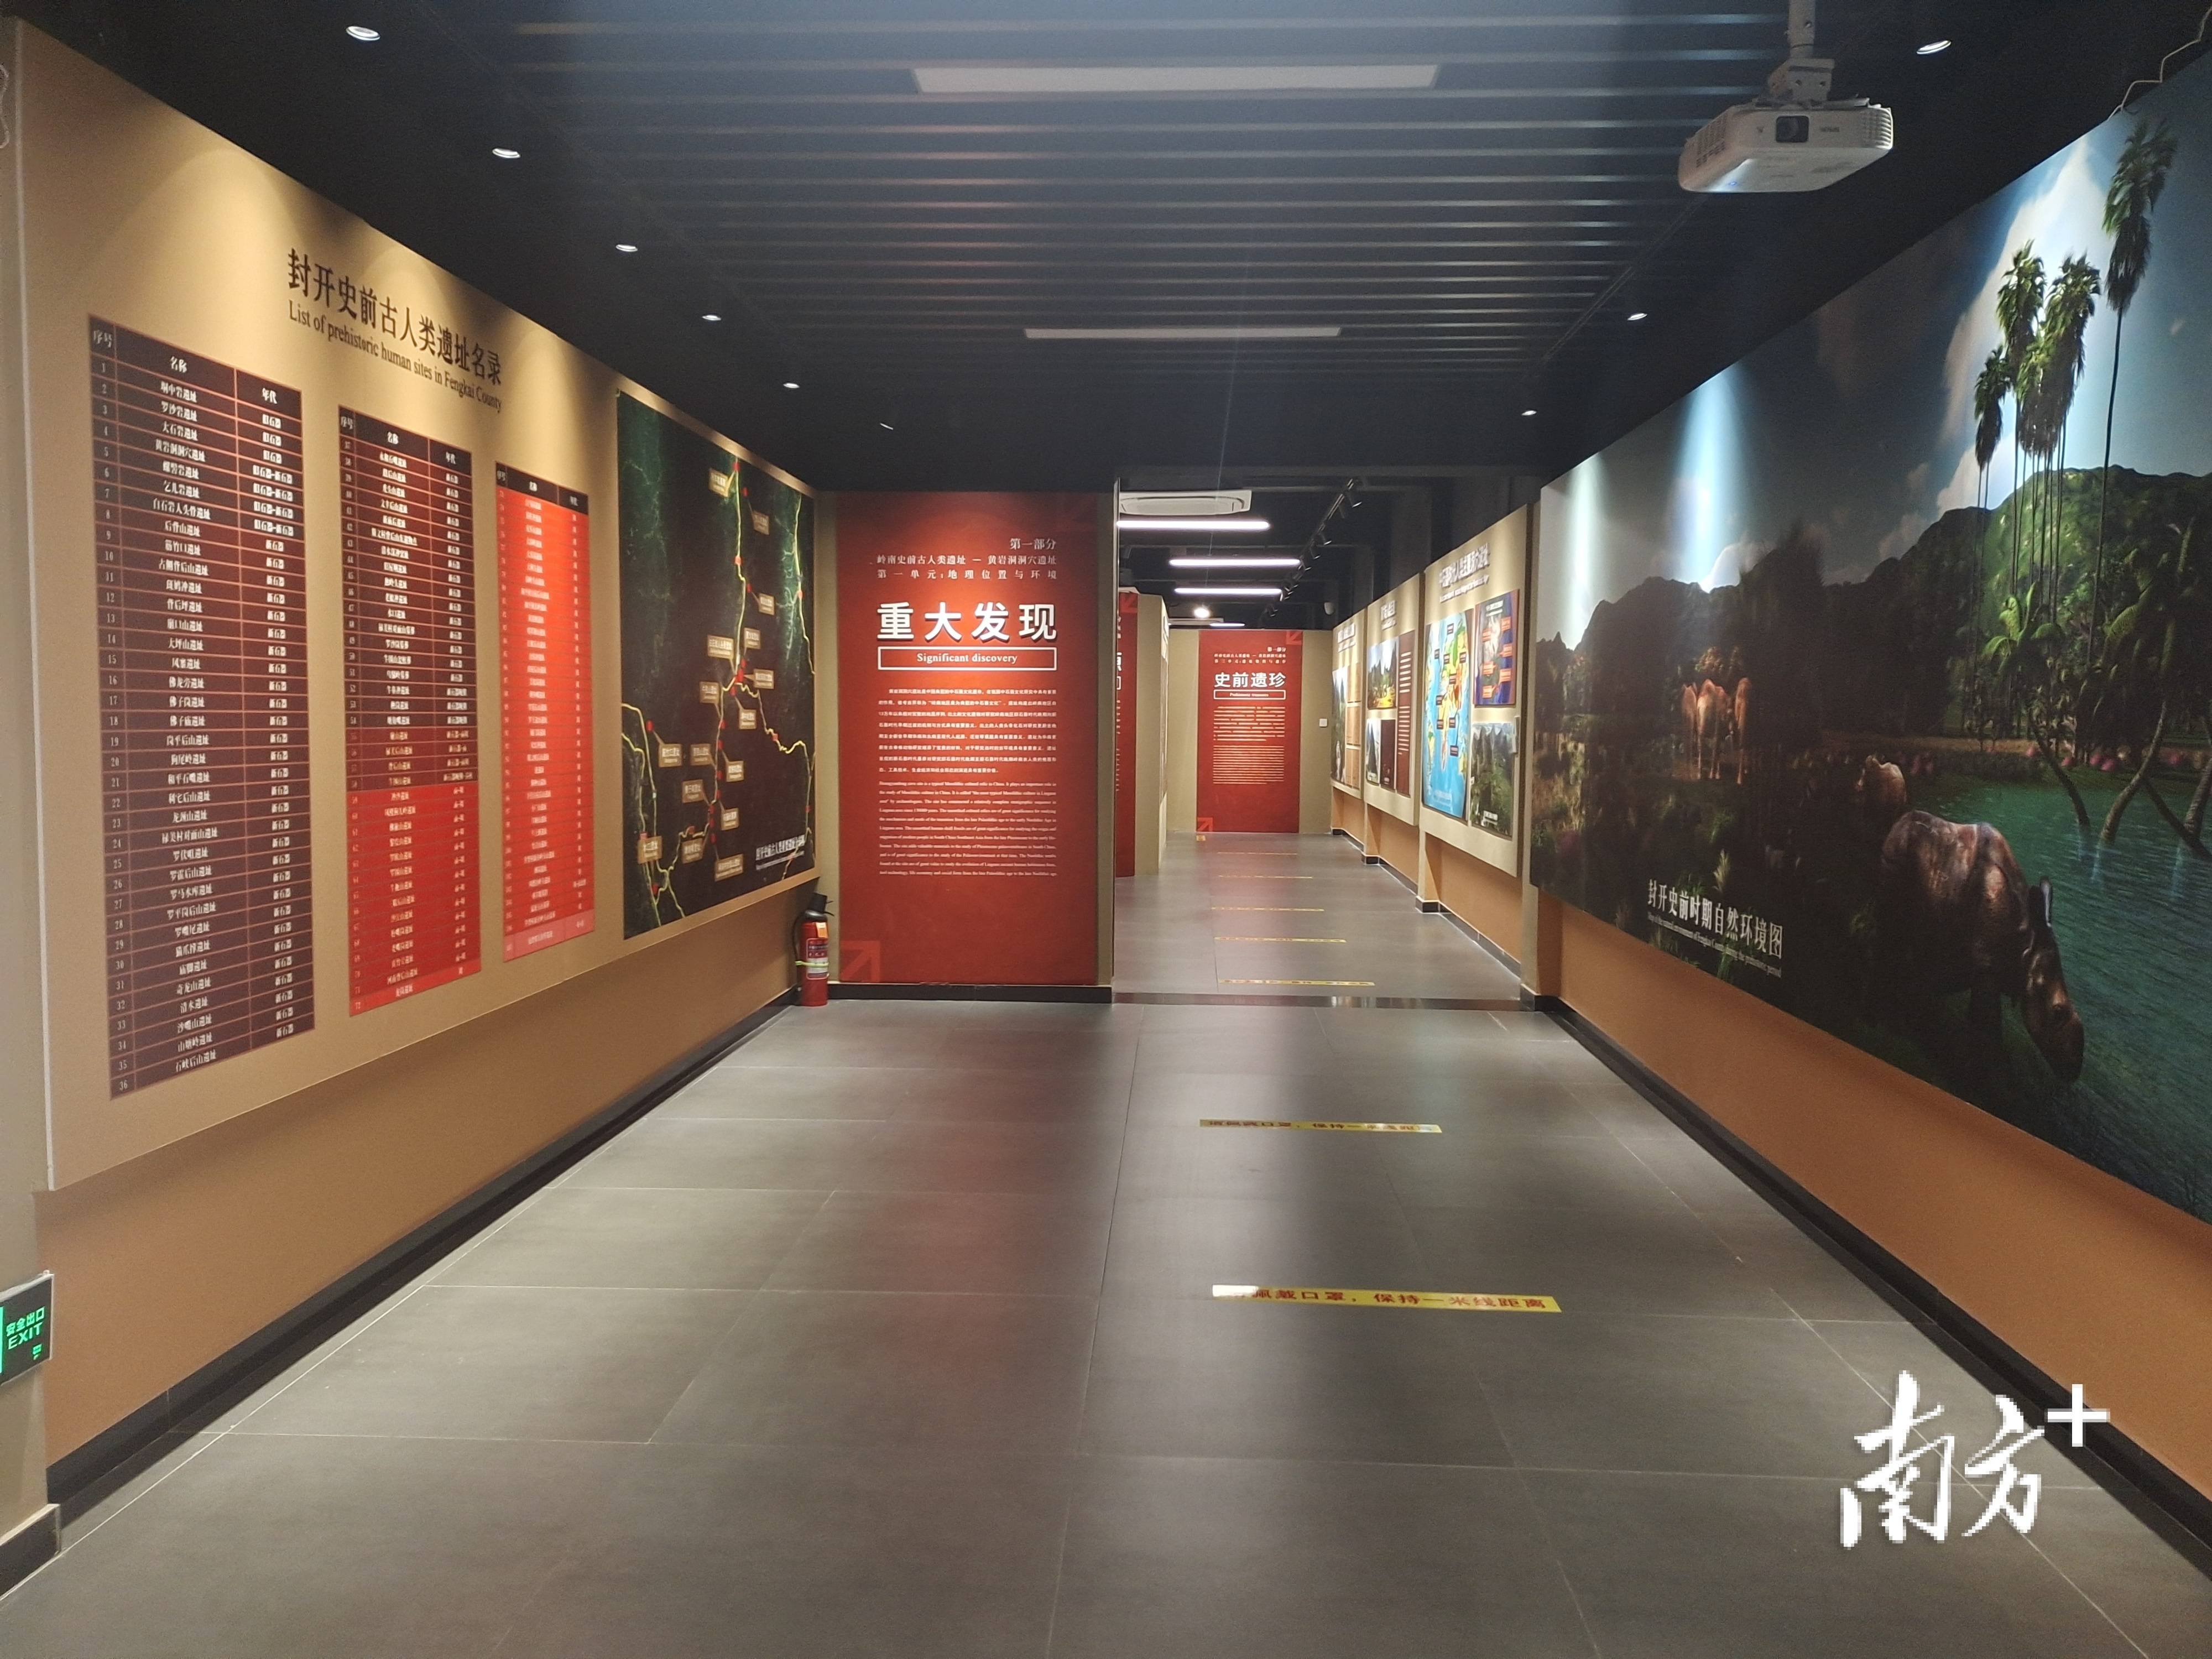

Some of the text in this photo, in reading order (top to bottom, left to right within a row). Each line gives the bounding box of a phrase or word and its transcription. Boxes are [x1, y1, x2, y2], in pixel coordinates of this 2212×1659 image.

[288, 248, 502, 386] 封开史前古人类遗址名录
[288, 299, 503, 414] List of prehistoric human sites in Fengkai County
[1009, 538, 1057, 551] 第一部分
[877, 555, 966, 566] 岭南史前古人类遗址
[987, 555, 1057, 566] 黄岩洞洞穴遗址
[877, 601, 1057, 642] 重大发现
[916, 653, 1018, 665] Significant discovery
[1214, 671, 1287, 688] 史前遗珍
[1647, 879, 1783, 959] 封开史前时期自然环境图
[6, 1306, 45, 1337] 安全出口
[8, 1321, 44, 1350] EXIT
